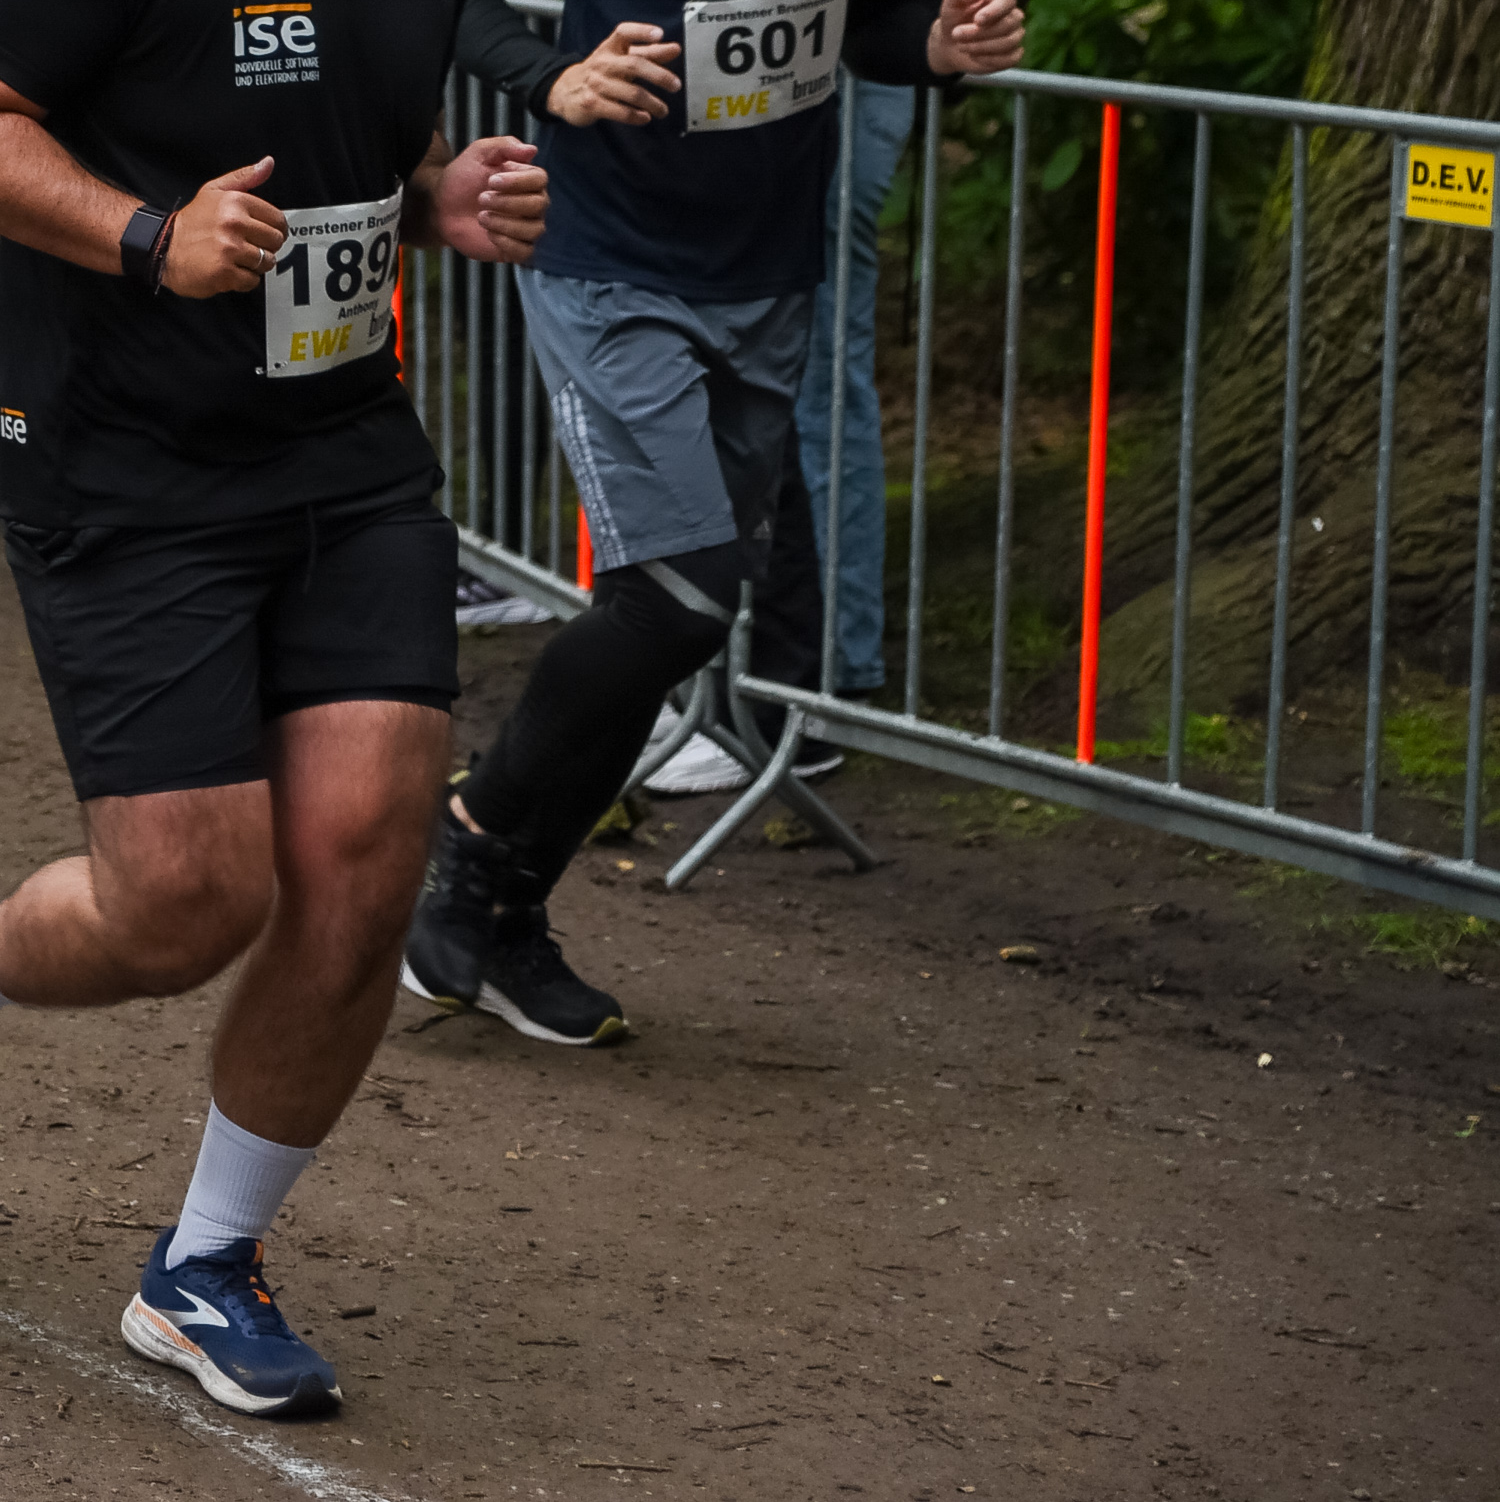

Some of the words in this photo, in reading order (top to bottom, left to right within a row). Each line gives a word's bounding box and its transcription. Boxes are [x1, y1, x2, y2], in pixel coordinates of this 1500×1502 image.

[697, 7, 774, 23] Everstener
[233, 7, 316, 57] ise
[715, 10, 828, 75] 601
[235, 59, 282, 74] INDIVIDUELLE
[235, 76, 253, 87] UND
[706, 90, 770, 120] EWE
[1412, 160, 1489, 195] D.E.V.
[289, 219, 364, 237] verstener
[0, 407, 27, 445] ise
